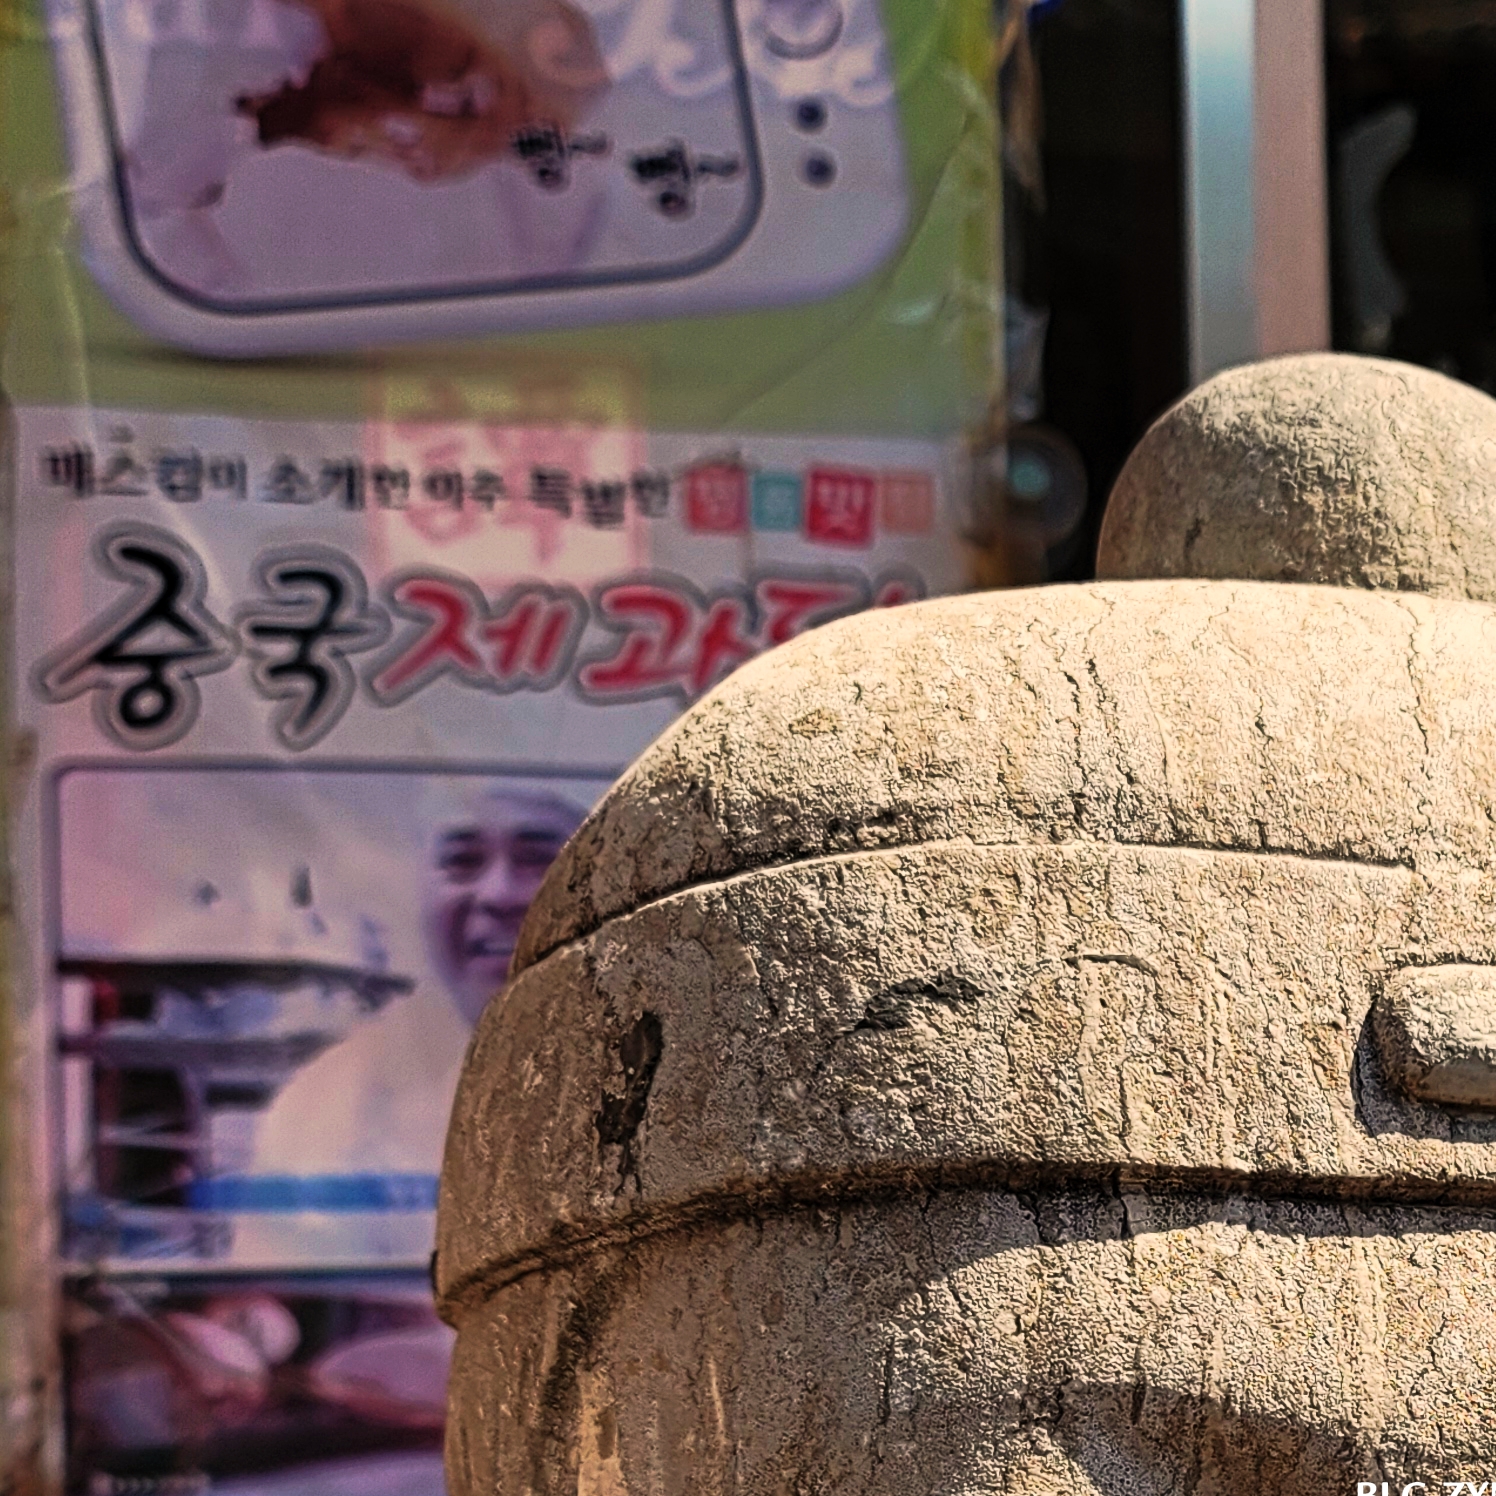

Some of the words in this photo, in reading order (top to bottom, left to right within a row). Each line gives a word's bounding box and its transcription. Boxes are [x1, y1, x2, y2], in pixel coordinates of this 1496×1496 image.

[258, 452, 410, 512] 소개한
[422, 464, 503, 512] 아주
[530, 462, 668, 530] 특별한
